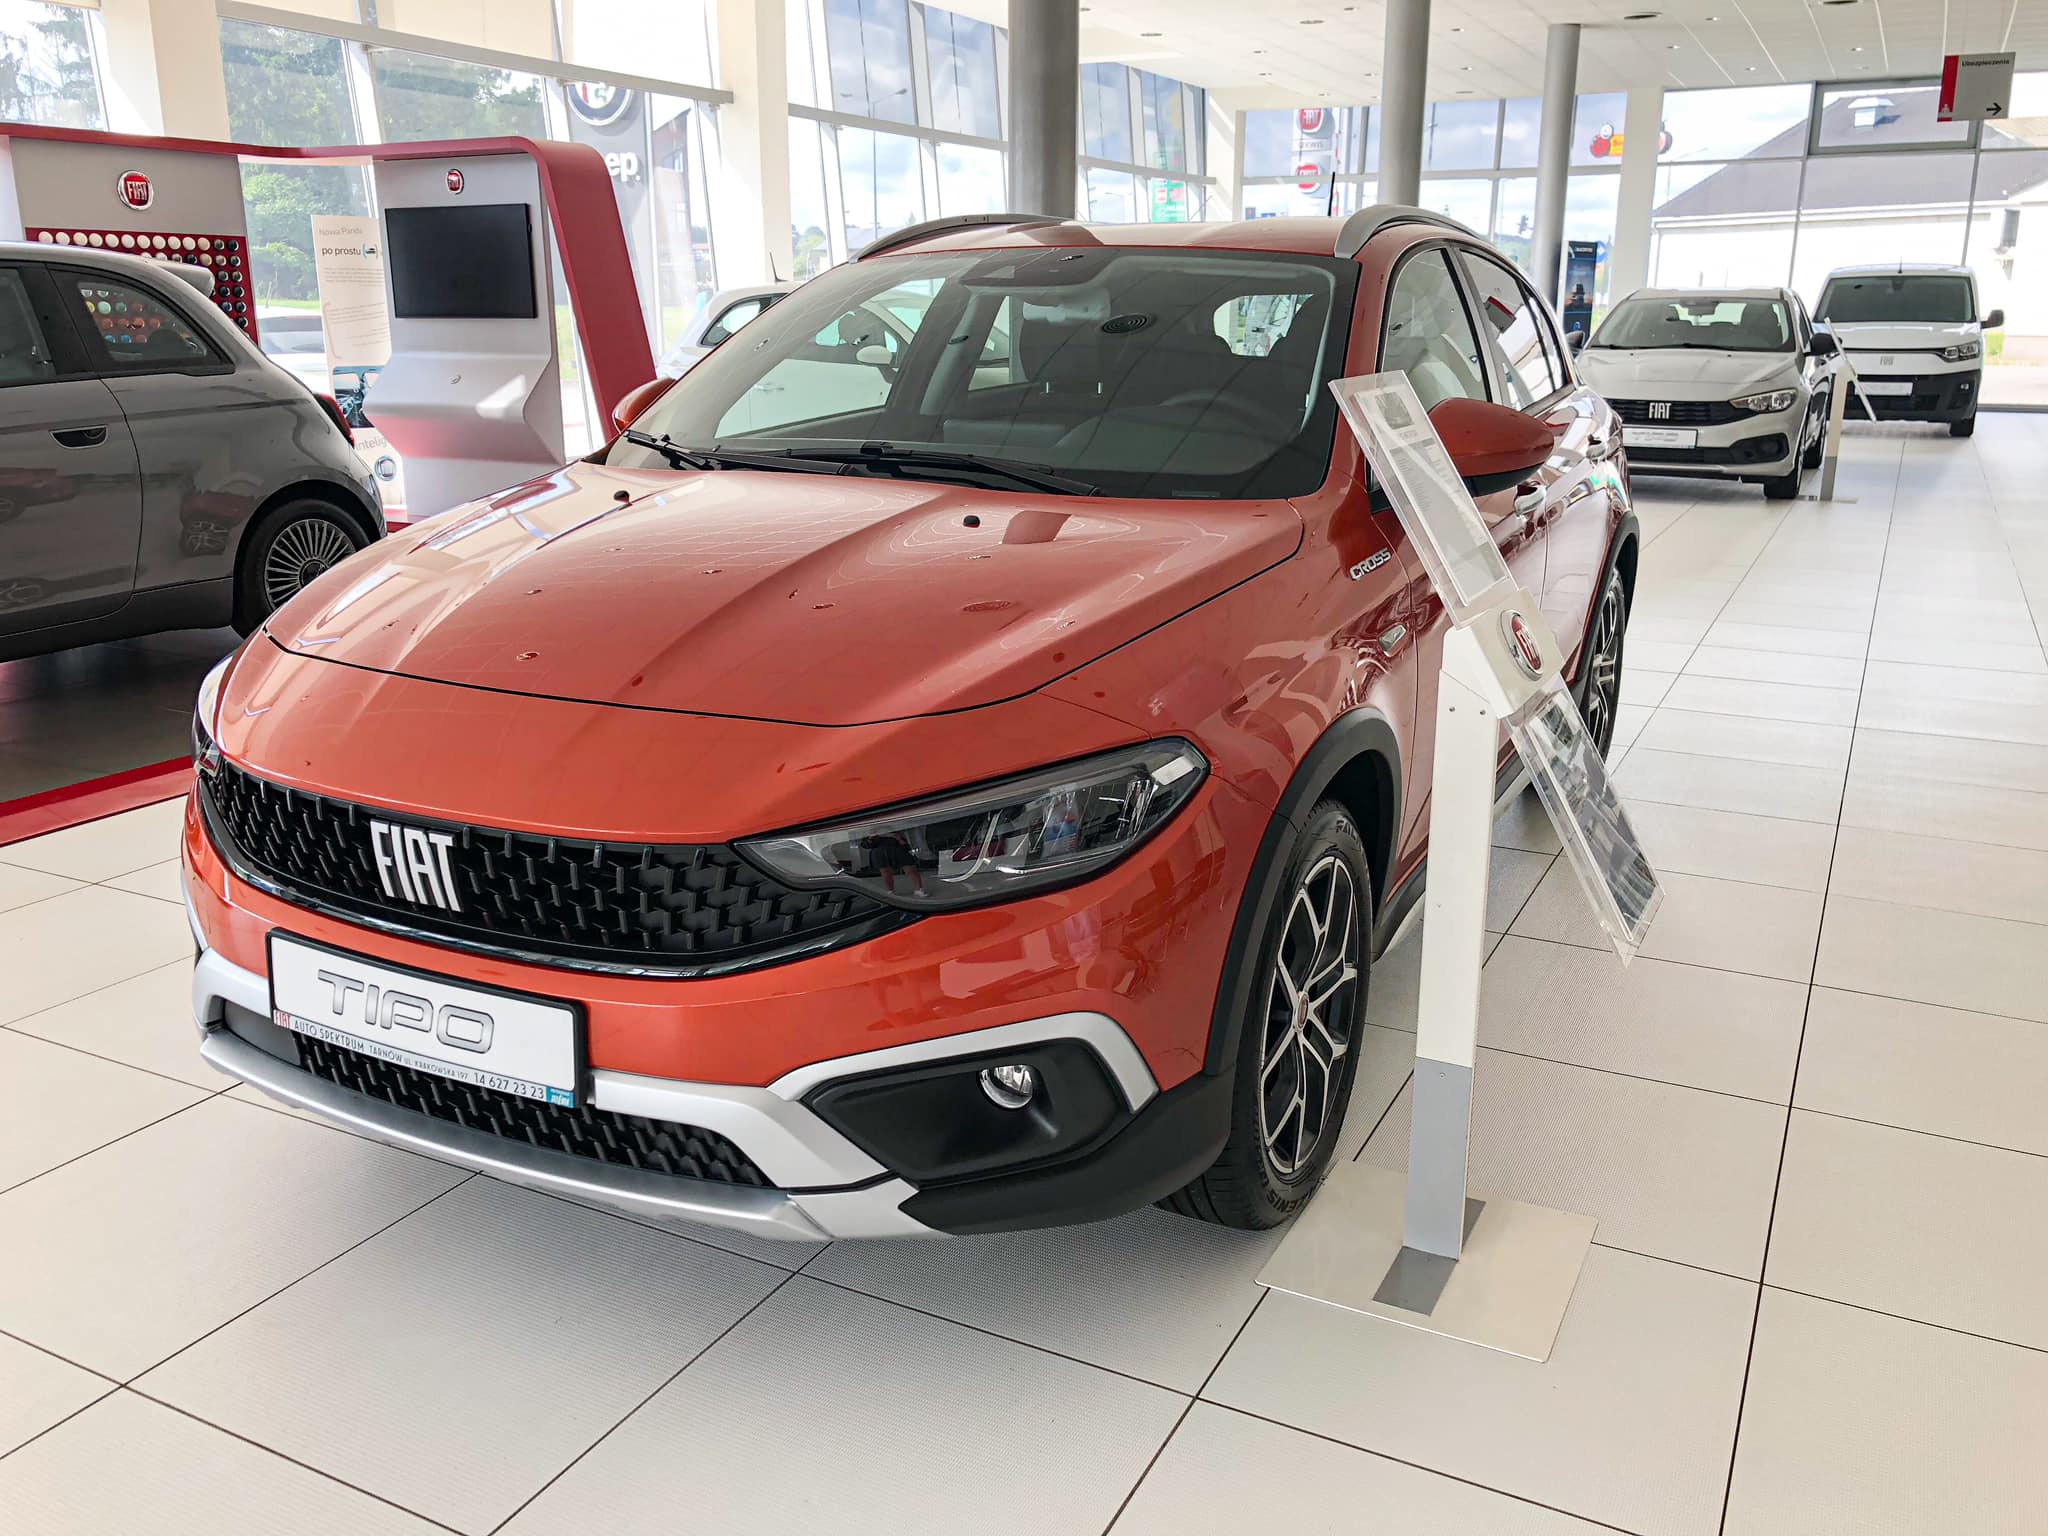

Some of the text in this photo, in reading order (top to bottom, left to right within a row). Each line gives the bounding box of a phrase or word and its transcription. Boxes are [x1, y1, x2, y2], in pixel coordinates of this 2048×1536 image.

[321, 246, 361, 257] po prostu
[1648, 402, 1672, 419] FIAT
[1350, 547, 1392, 580] CROSS
[370, 818, 462, 913] FIAT
[317, 968, 495, 1054] TIPO
[294, 1020, 317, 1036] AUTO
[320, 1028, 365, 1052] SPEKTRUM
[474, 1072, 485, 1086] 14
[489, 1076, 509, 1090] 627
[513, 1082, 527, 1096] 23
[531, 1086, 544, 1099] 23
